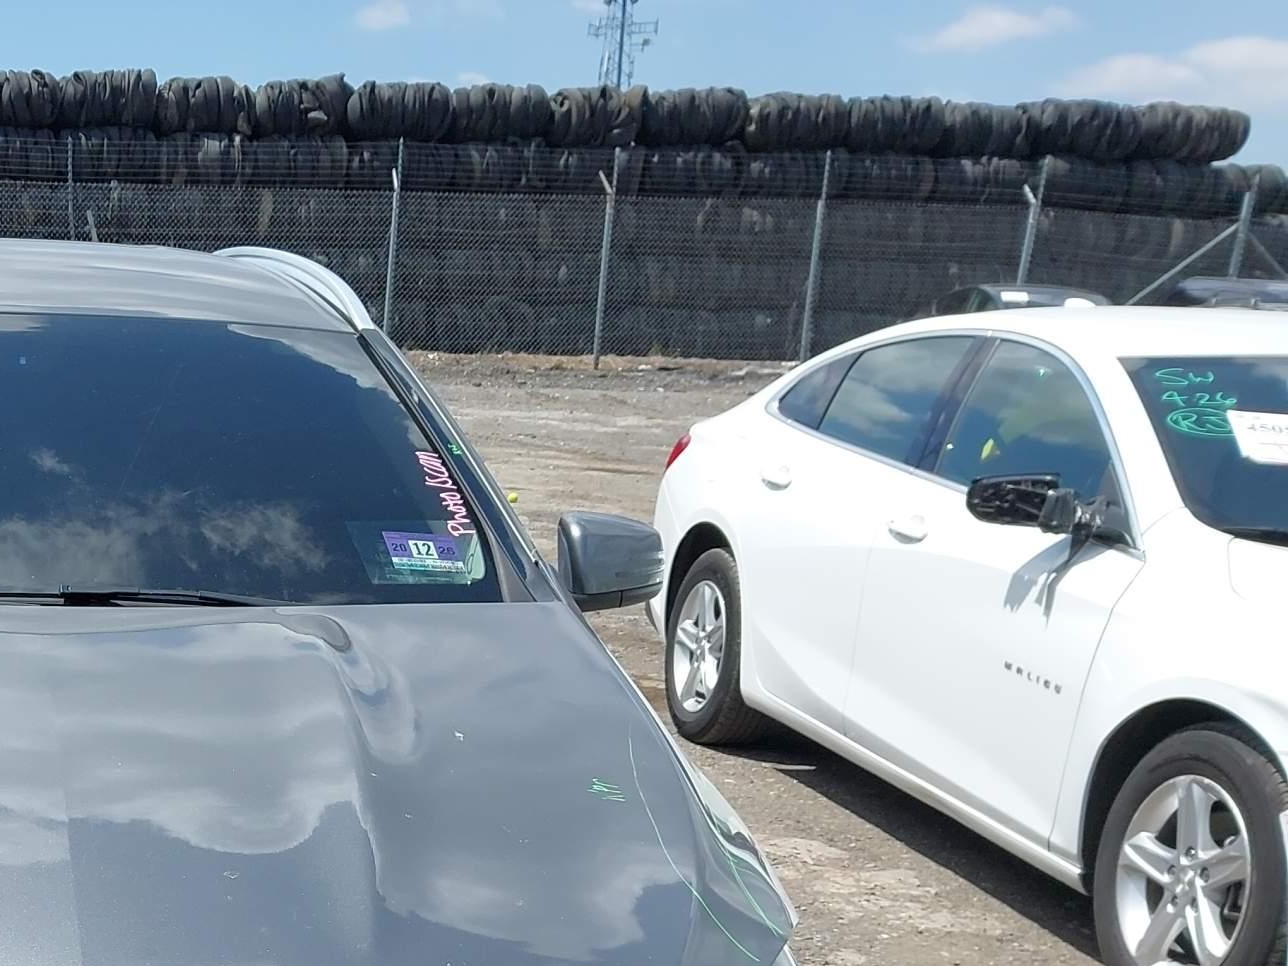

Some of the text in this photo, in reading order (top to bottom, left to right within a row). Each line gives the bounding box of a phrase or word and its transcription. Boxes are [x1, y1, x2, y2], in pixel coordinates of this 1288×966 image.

[1247, 424, 1288, 434] 450
[391, 543, 408, 552] 20
[412, 542, 435, 557] 12
